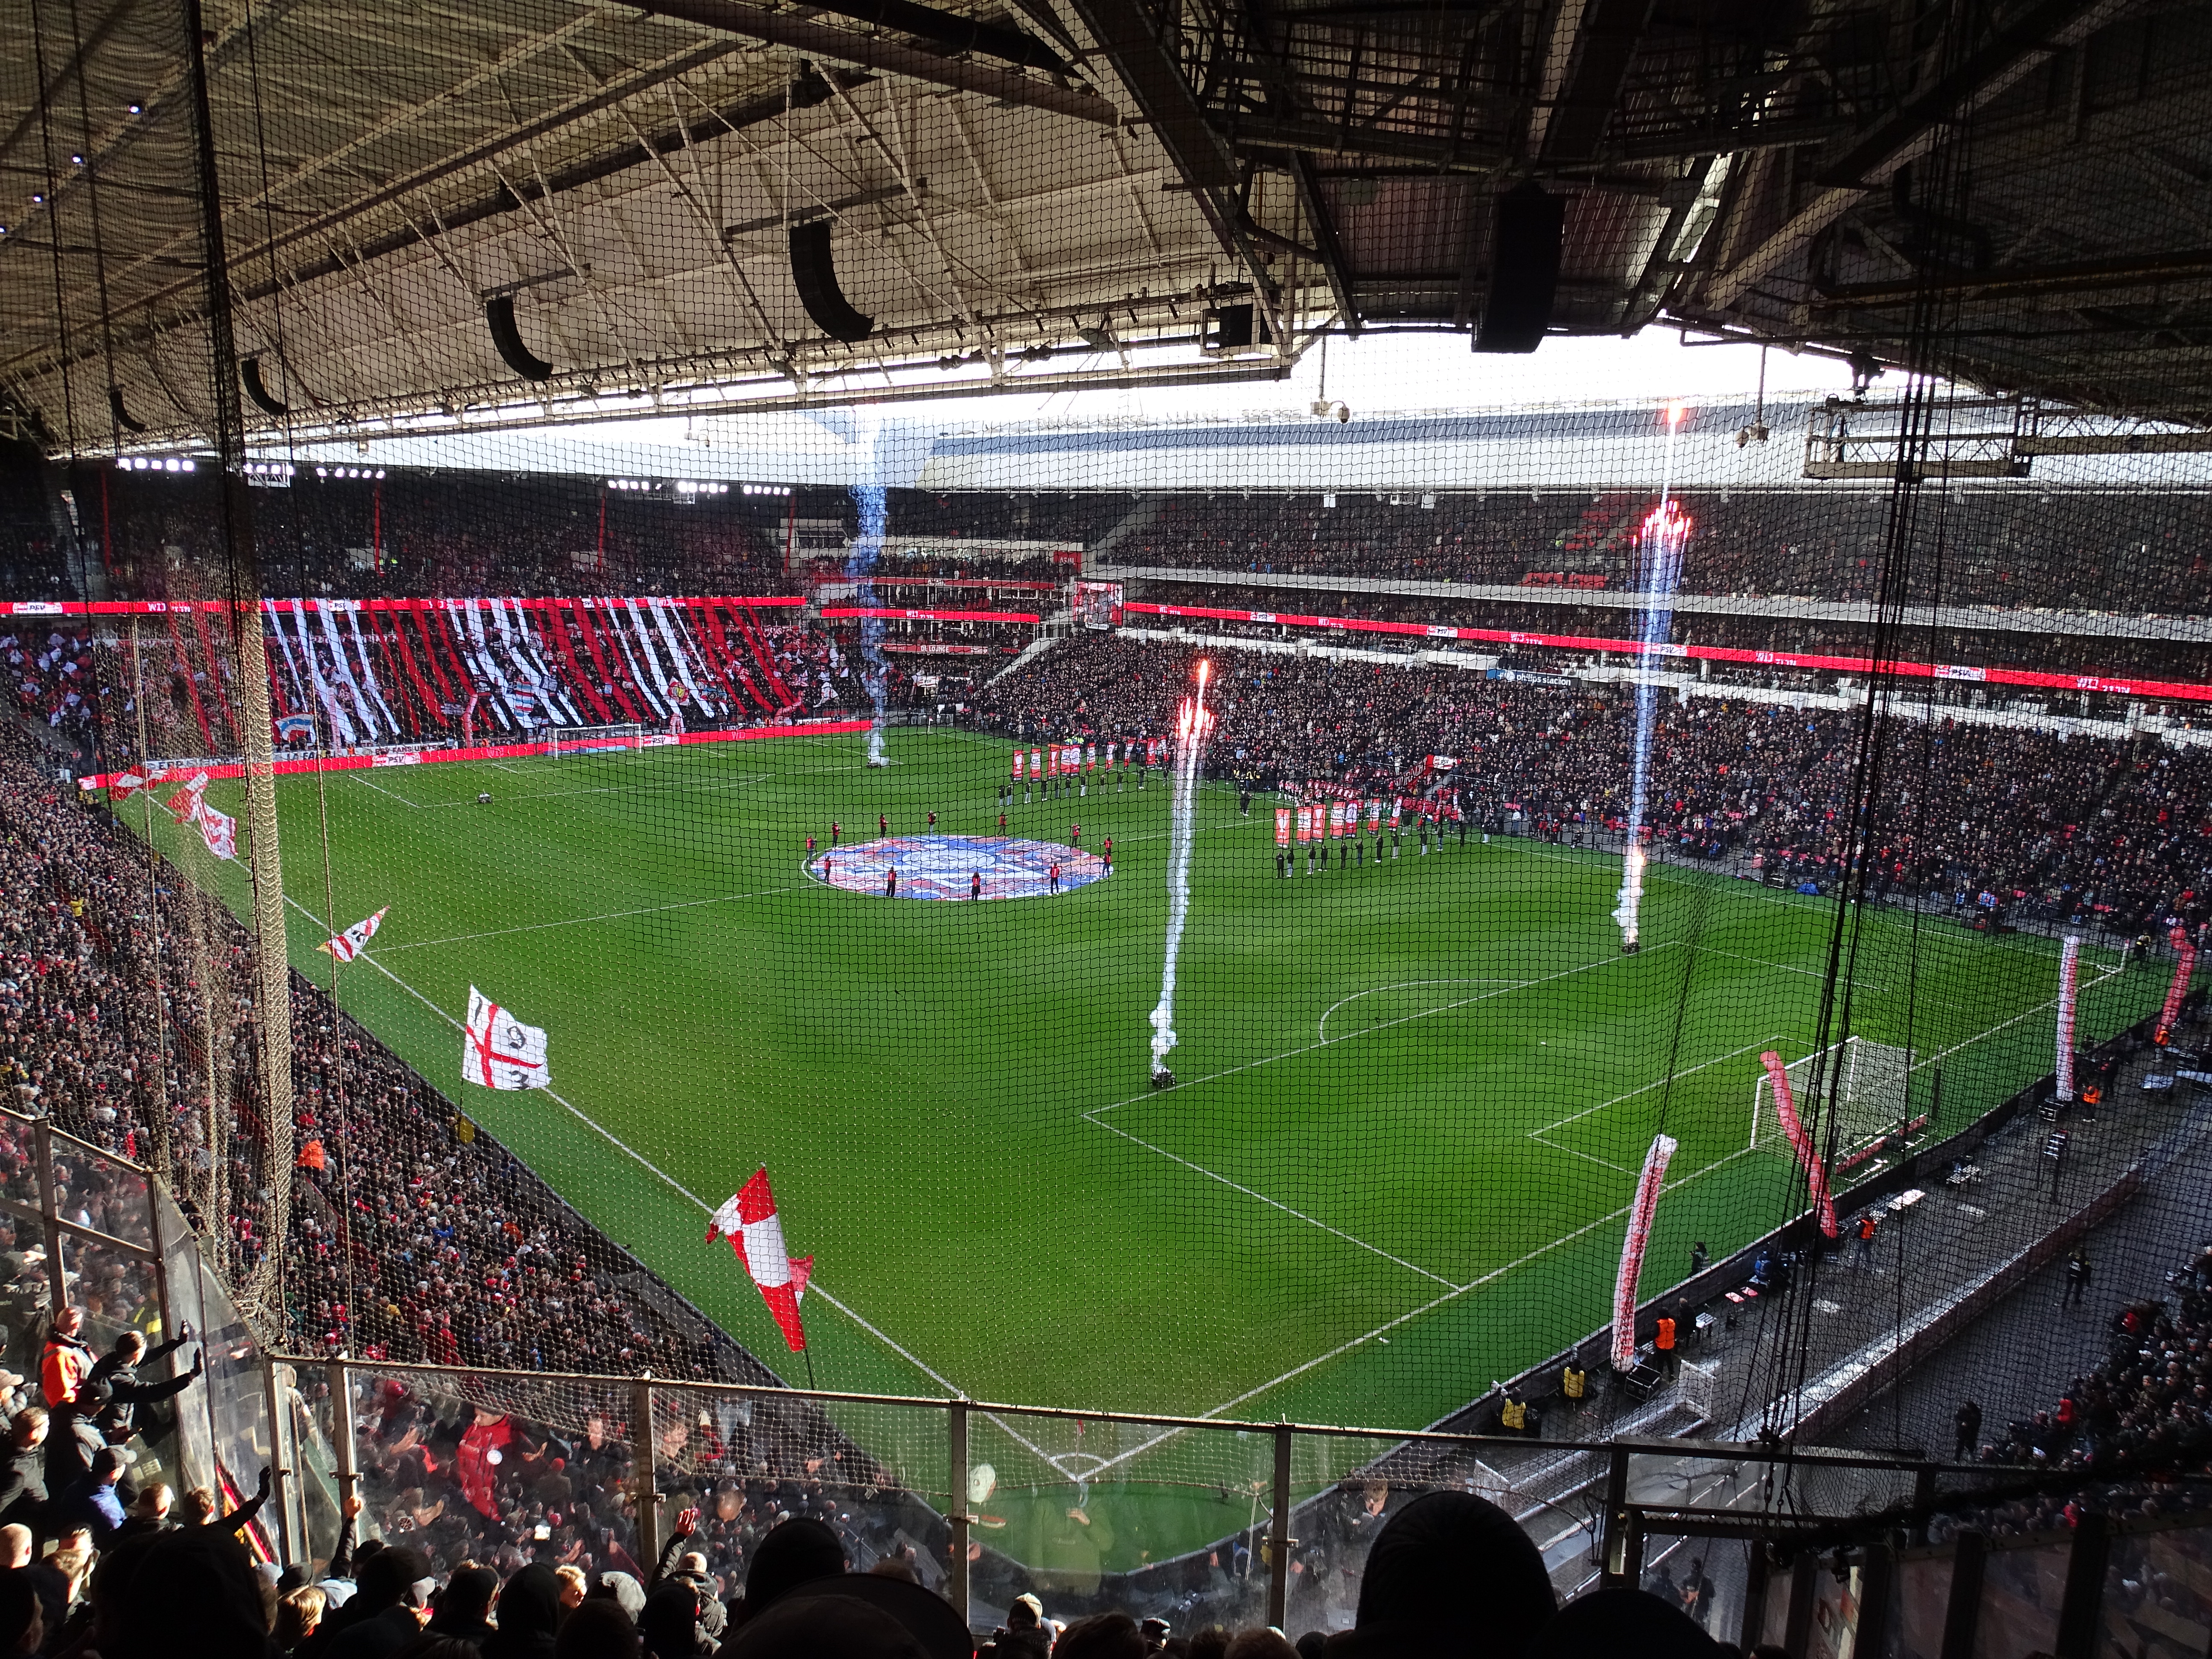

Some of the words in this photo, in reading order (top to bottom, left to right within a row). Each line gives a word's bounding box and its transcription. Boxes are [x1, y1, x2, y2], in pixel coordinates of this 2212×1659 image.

[148, 603, 166, 611] WIJ
[1318, 618, 1329, 626] WIJ
[1511, 633, 1525, 642] WIJ
[1756, 652, 1773, 662] WIJ
[1516, 674, 1541, 684] philips
[1543, 676, 1571, 686] stadion
[2077, 677, 2098, 689] WIJ
[486, 748, 504, 757] WIJ
